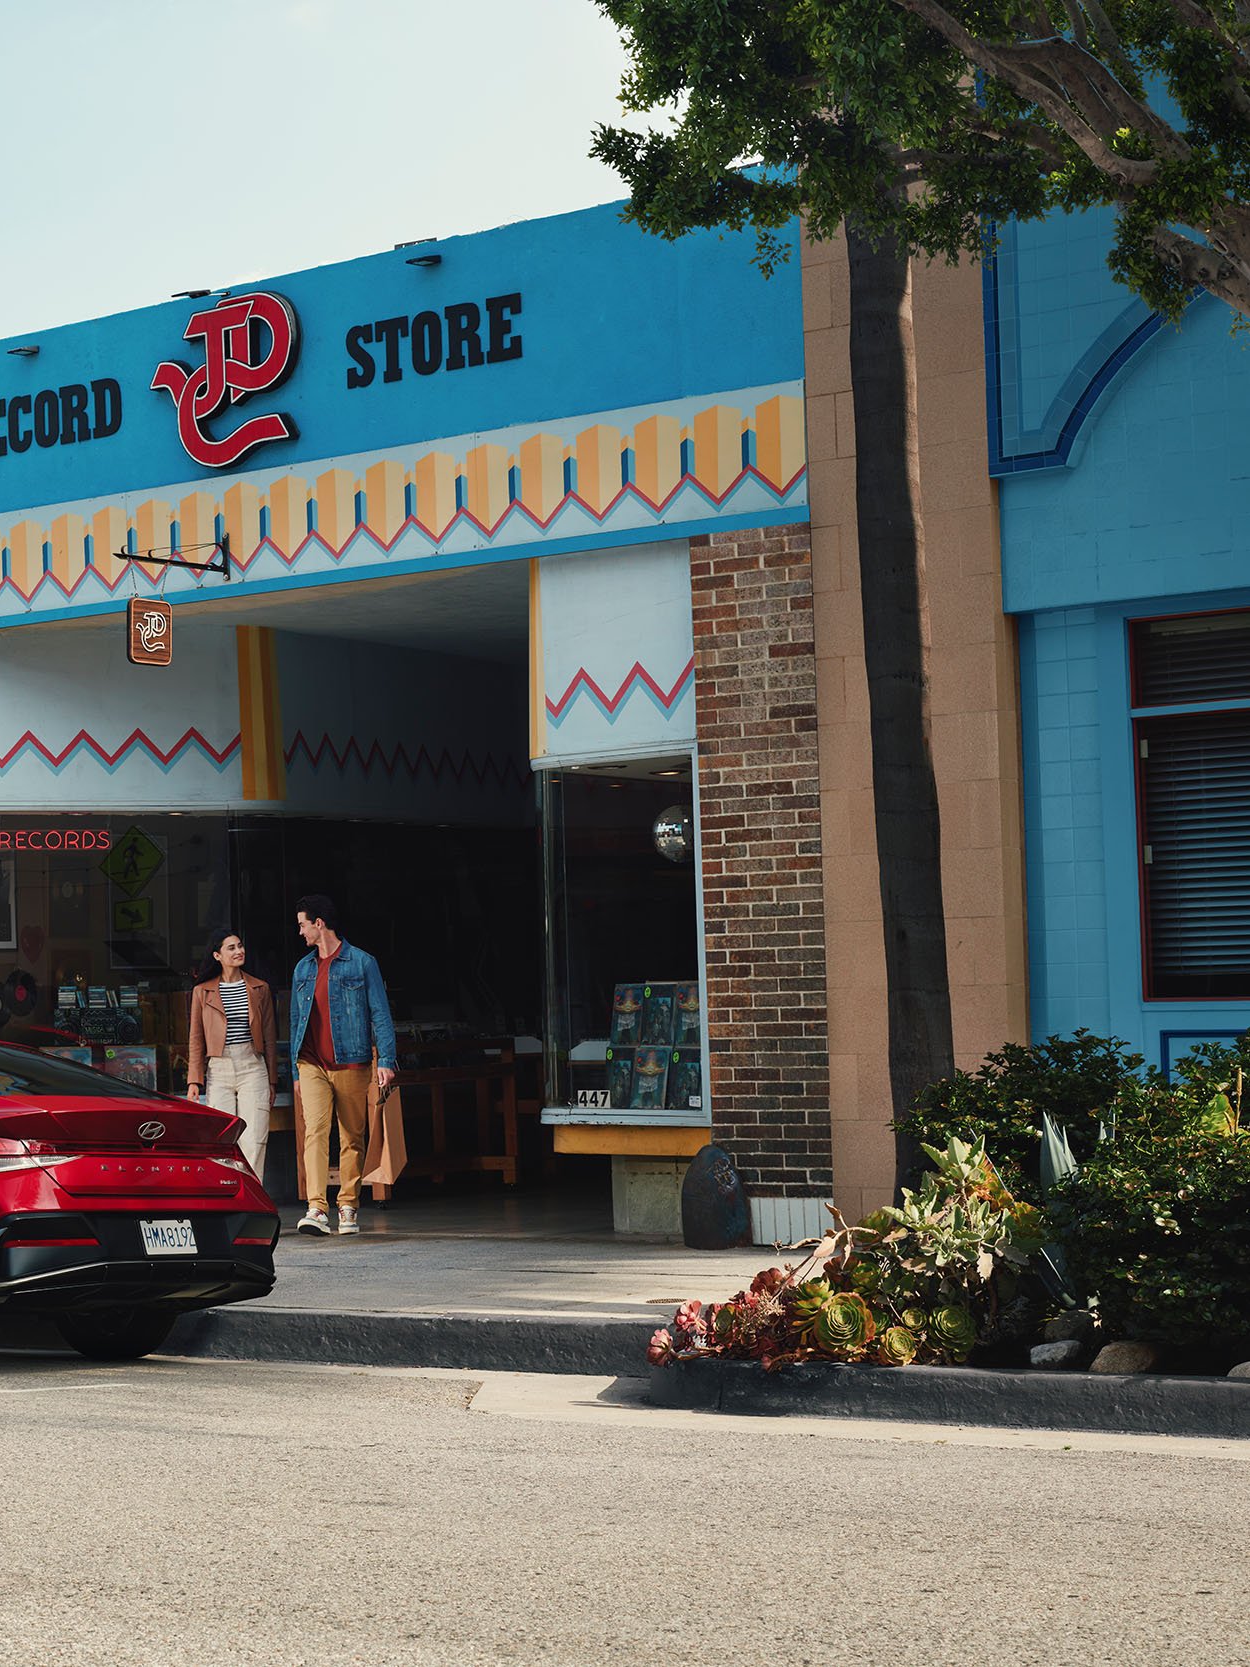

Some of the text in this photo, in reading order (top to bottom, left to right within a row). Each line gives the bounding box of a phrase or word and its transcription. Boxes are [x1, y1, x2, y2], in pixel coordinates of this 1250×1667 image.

[345, 292, 522, 389] STORE
[579, 1091, 609, 1107] 447
[144, 1226, 196, 1248] HMA8192
